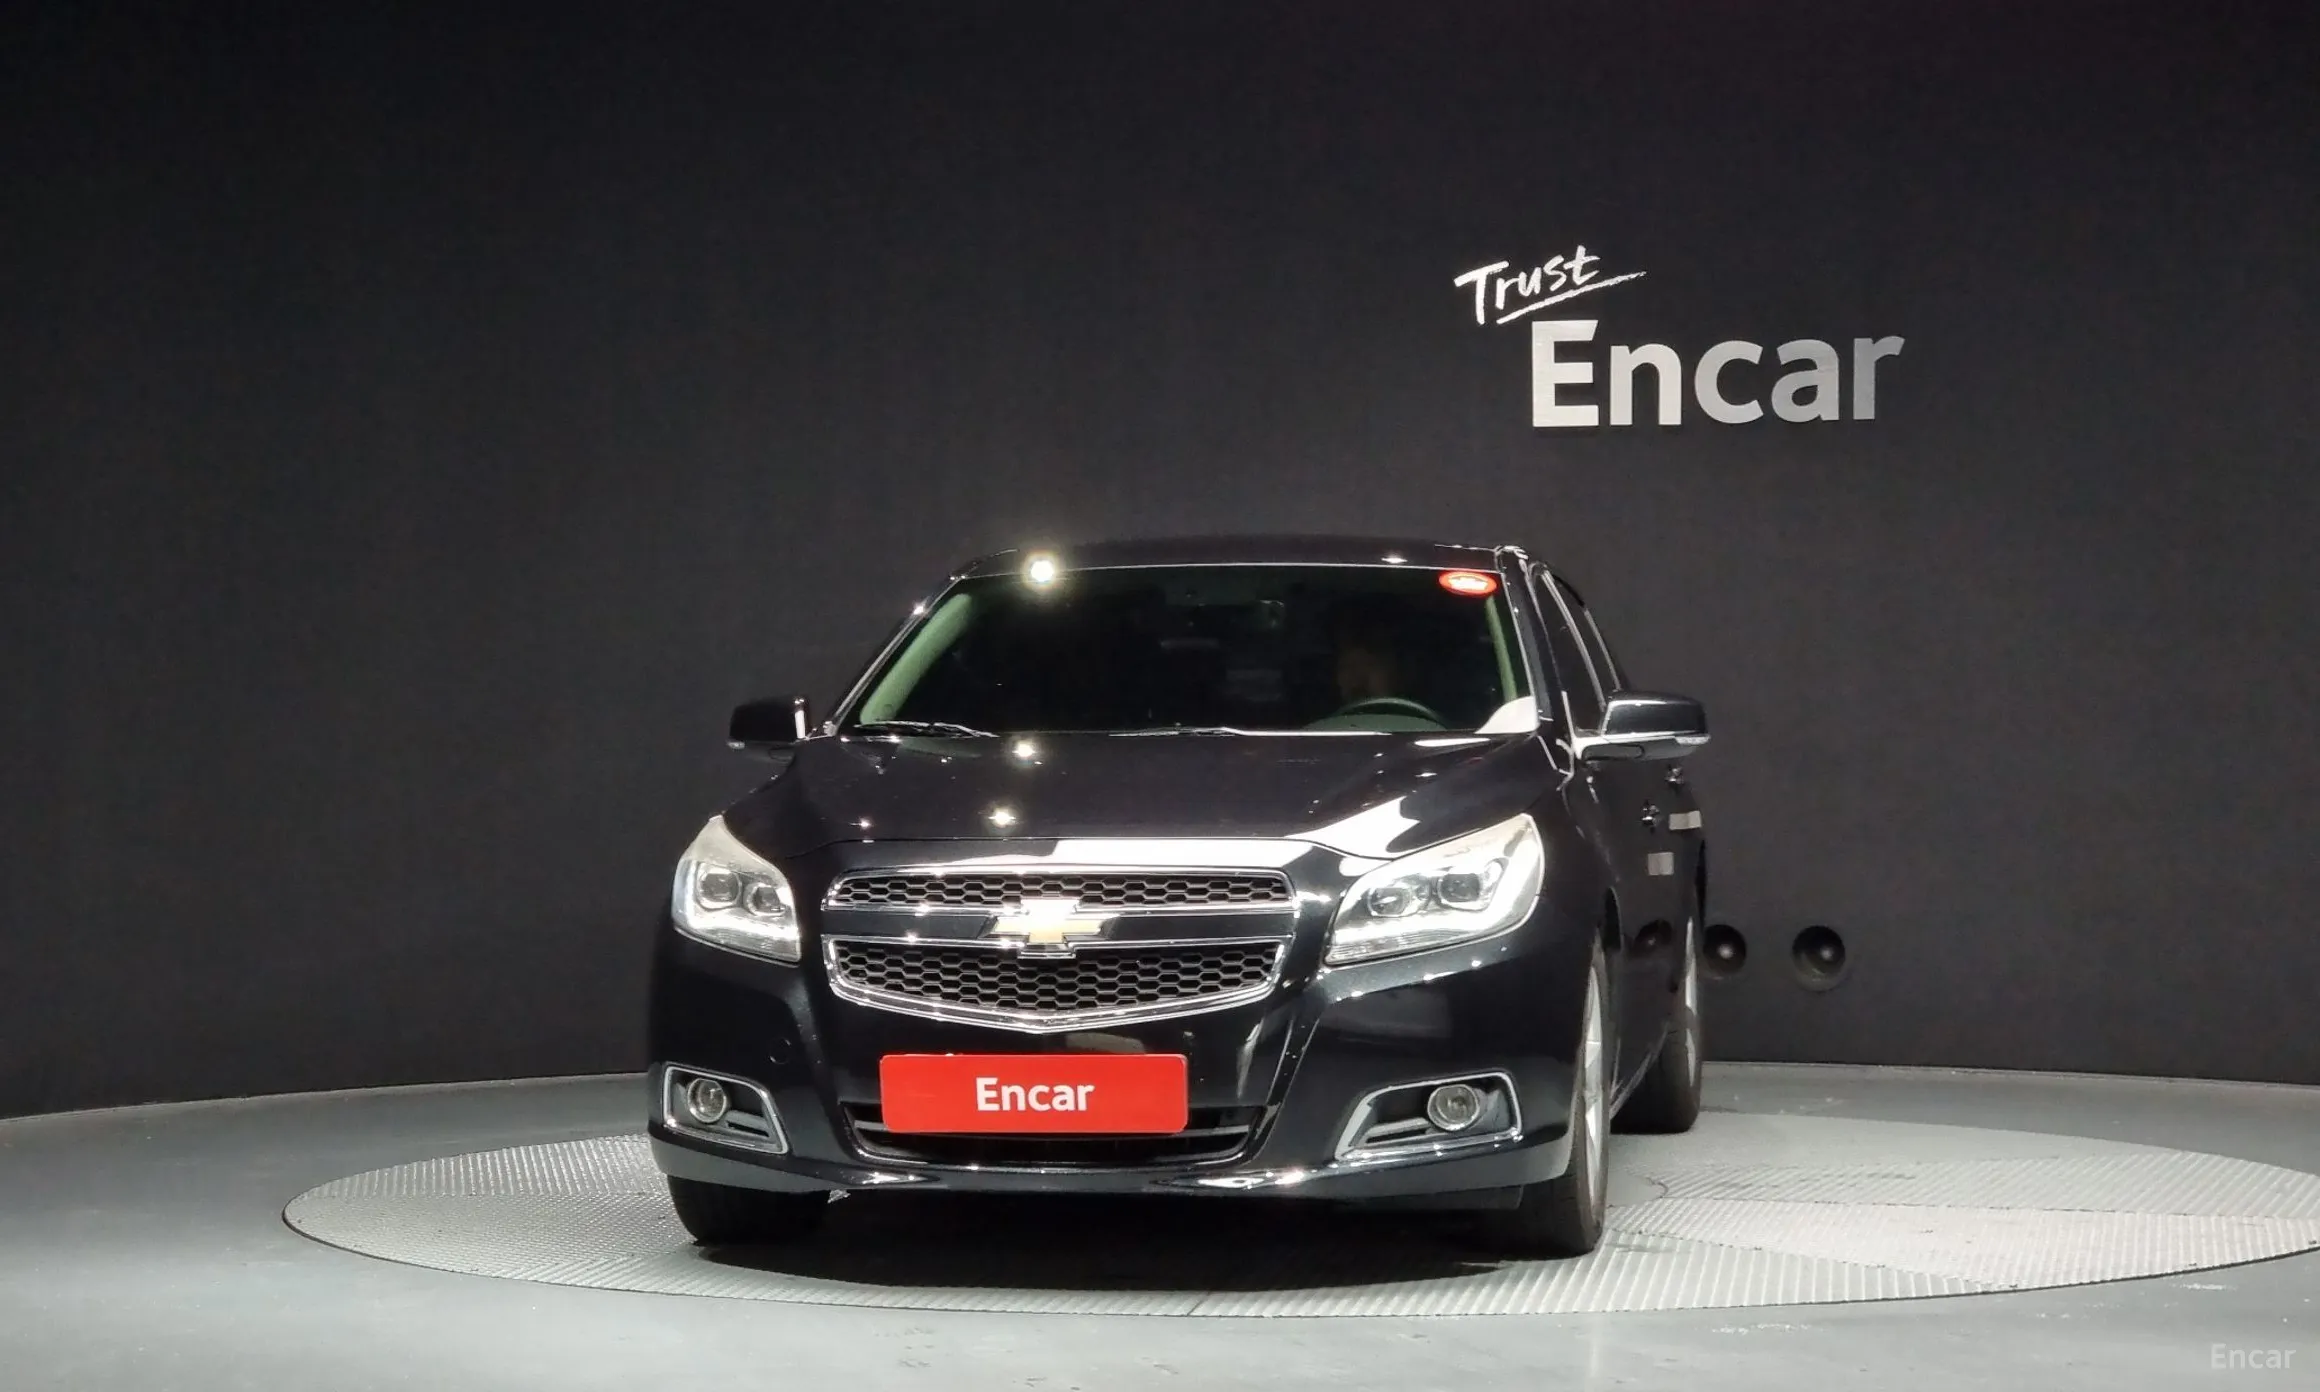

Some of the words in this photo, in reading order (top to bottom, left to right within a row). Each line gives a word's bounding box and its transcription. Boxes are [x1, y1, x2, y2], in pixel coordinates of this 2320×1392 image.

[1453, 245, 1601, 325] Trust
[1531, 319, 1906, 428] Encar
[975, 1076, 1095, 1112] Encar
